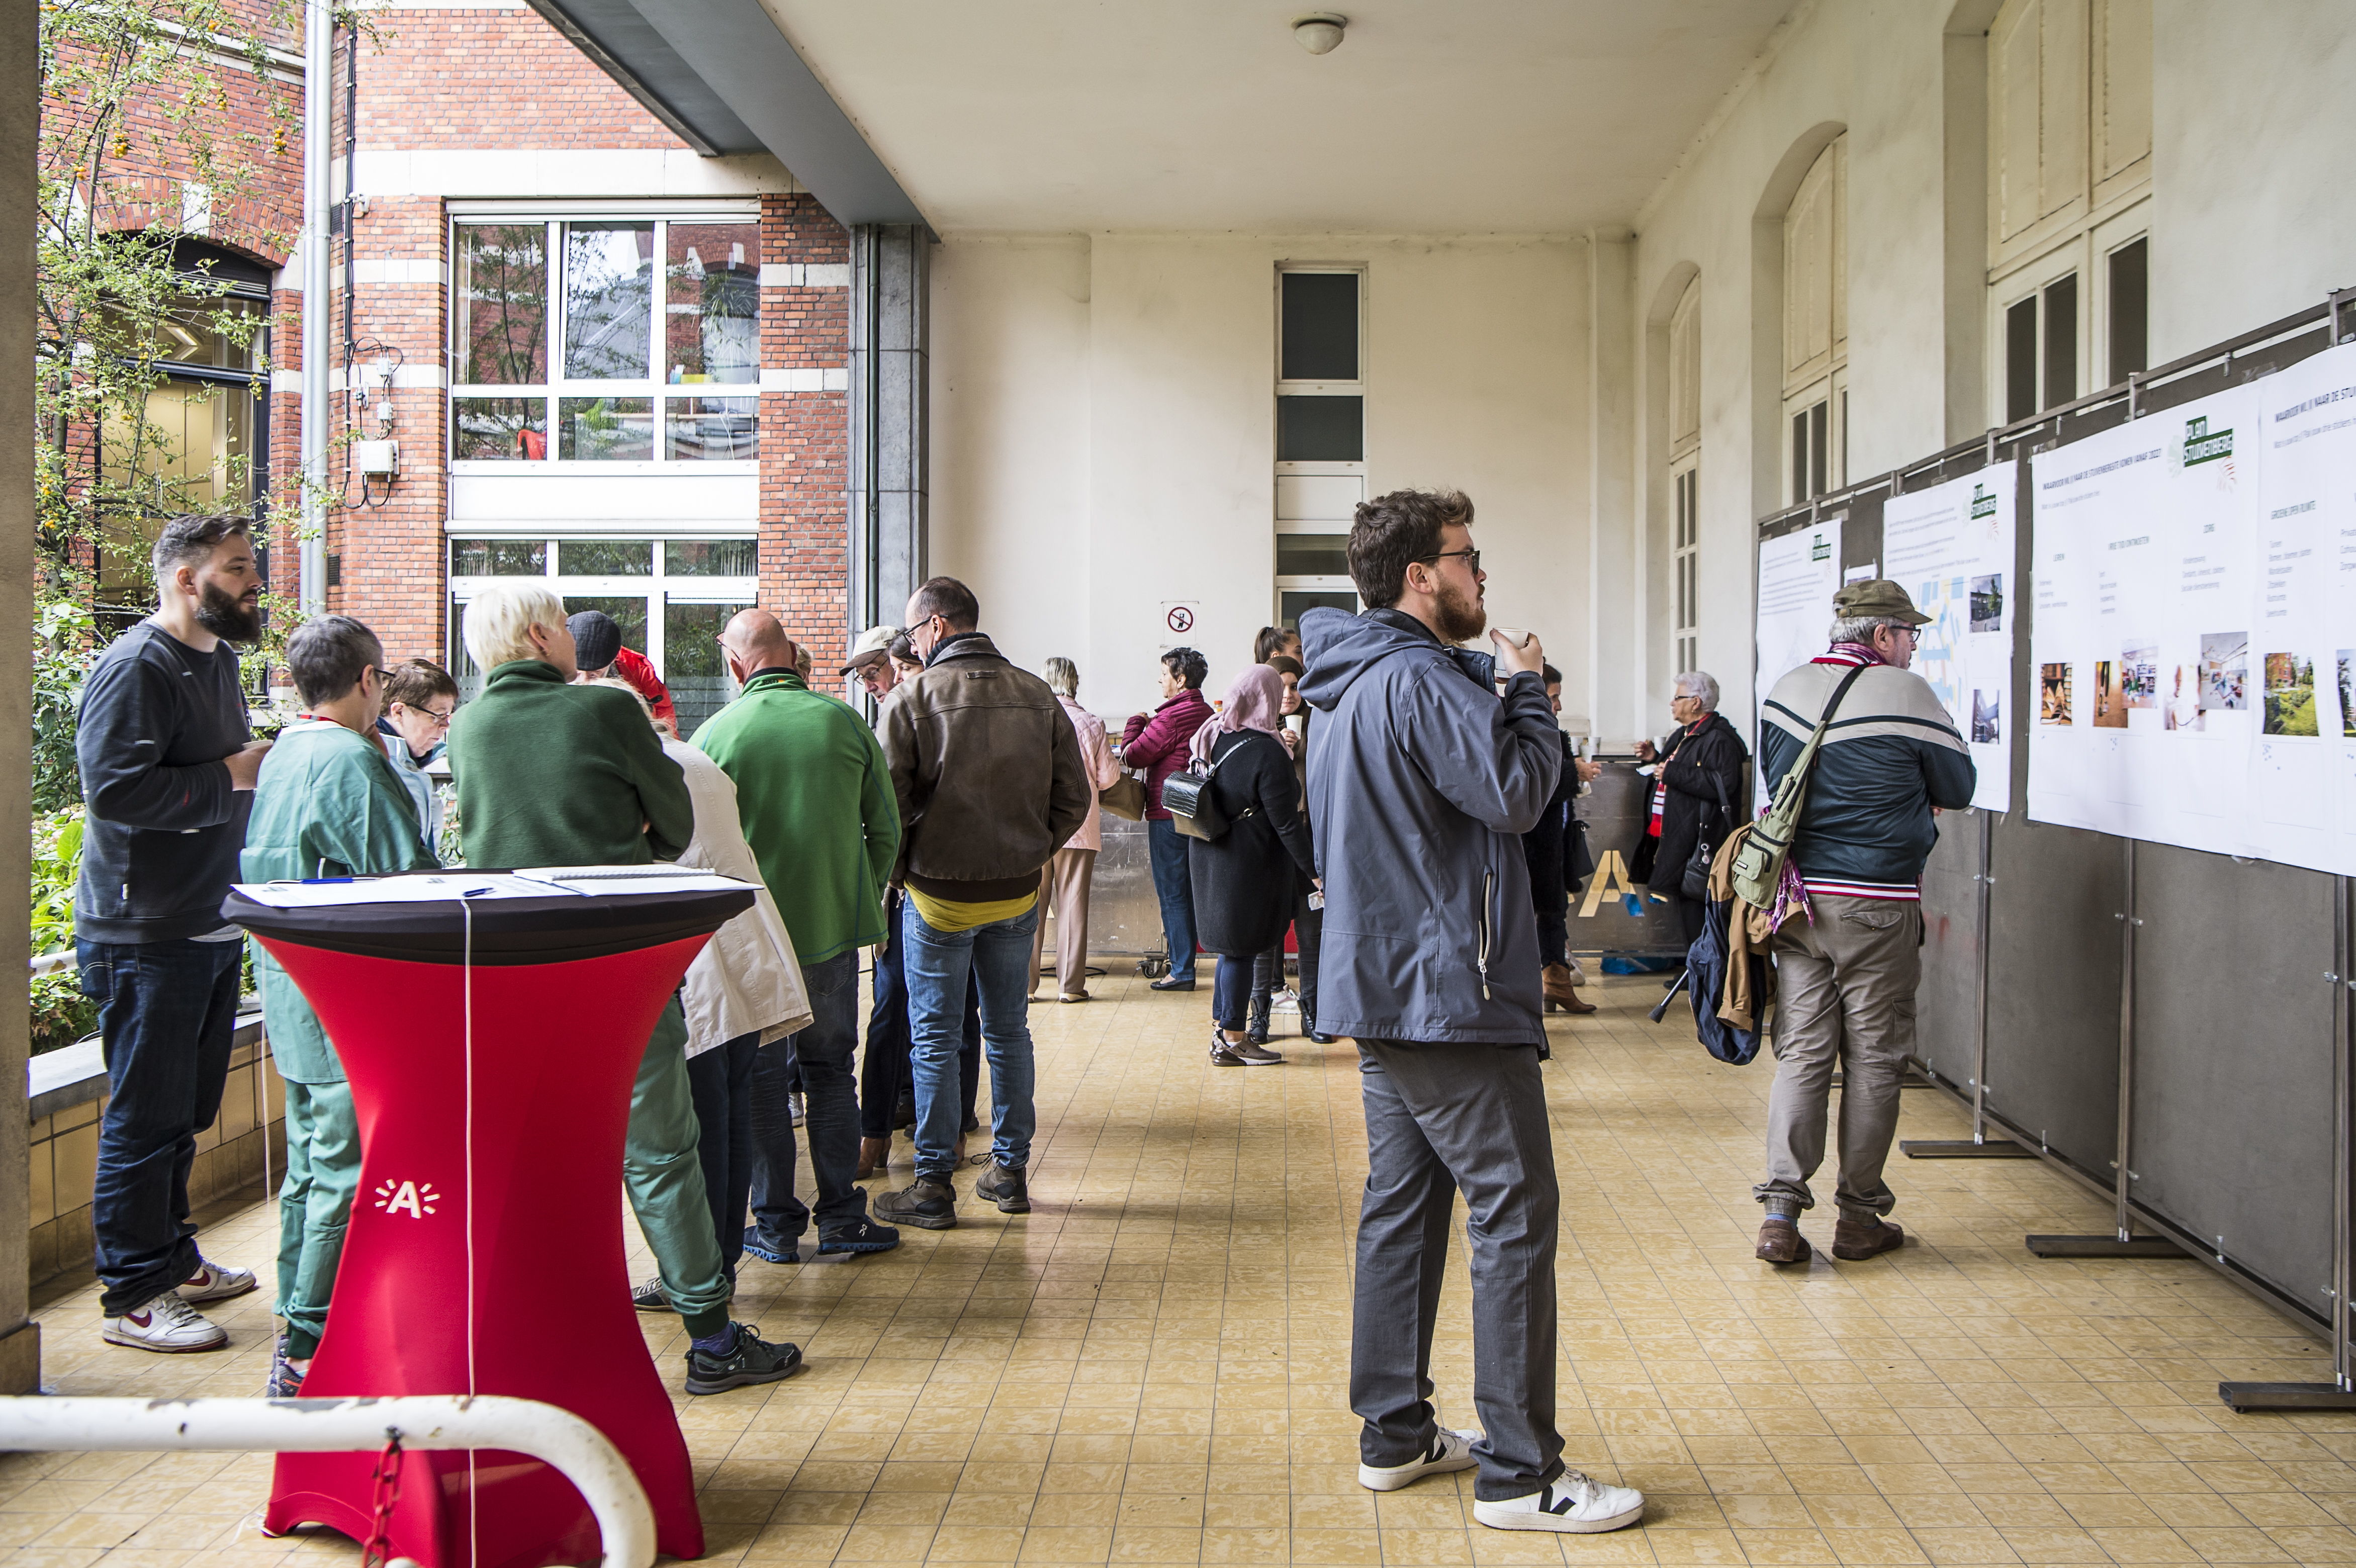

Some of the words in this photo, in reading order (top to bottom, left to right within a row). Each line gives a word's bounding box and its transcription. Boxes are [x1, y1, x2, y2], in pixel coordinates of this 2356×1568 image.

[2186, 420, 2206, 440] PLAN
[2184, 434, 2233, 463] STUIVENBERG
[386, 1181, 422, 1219] A
